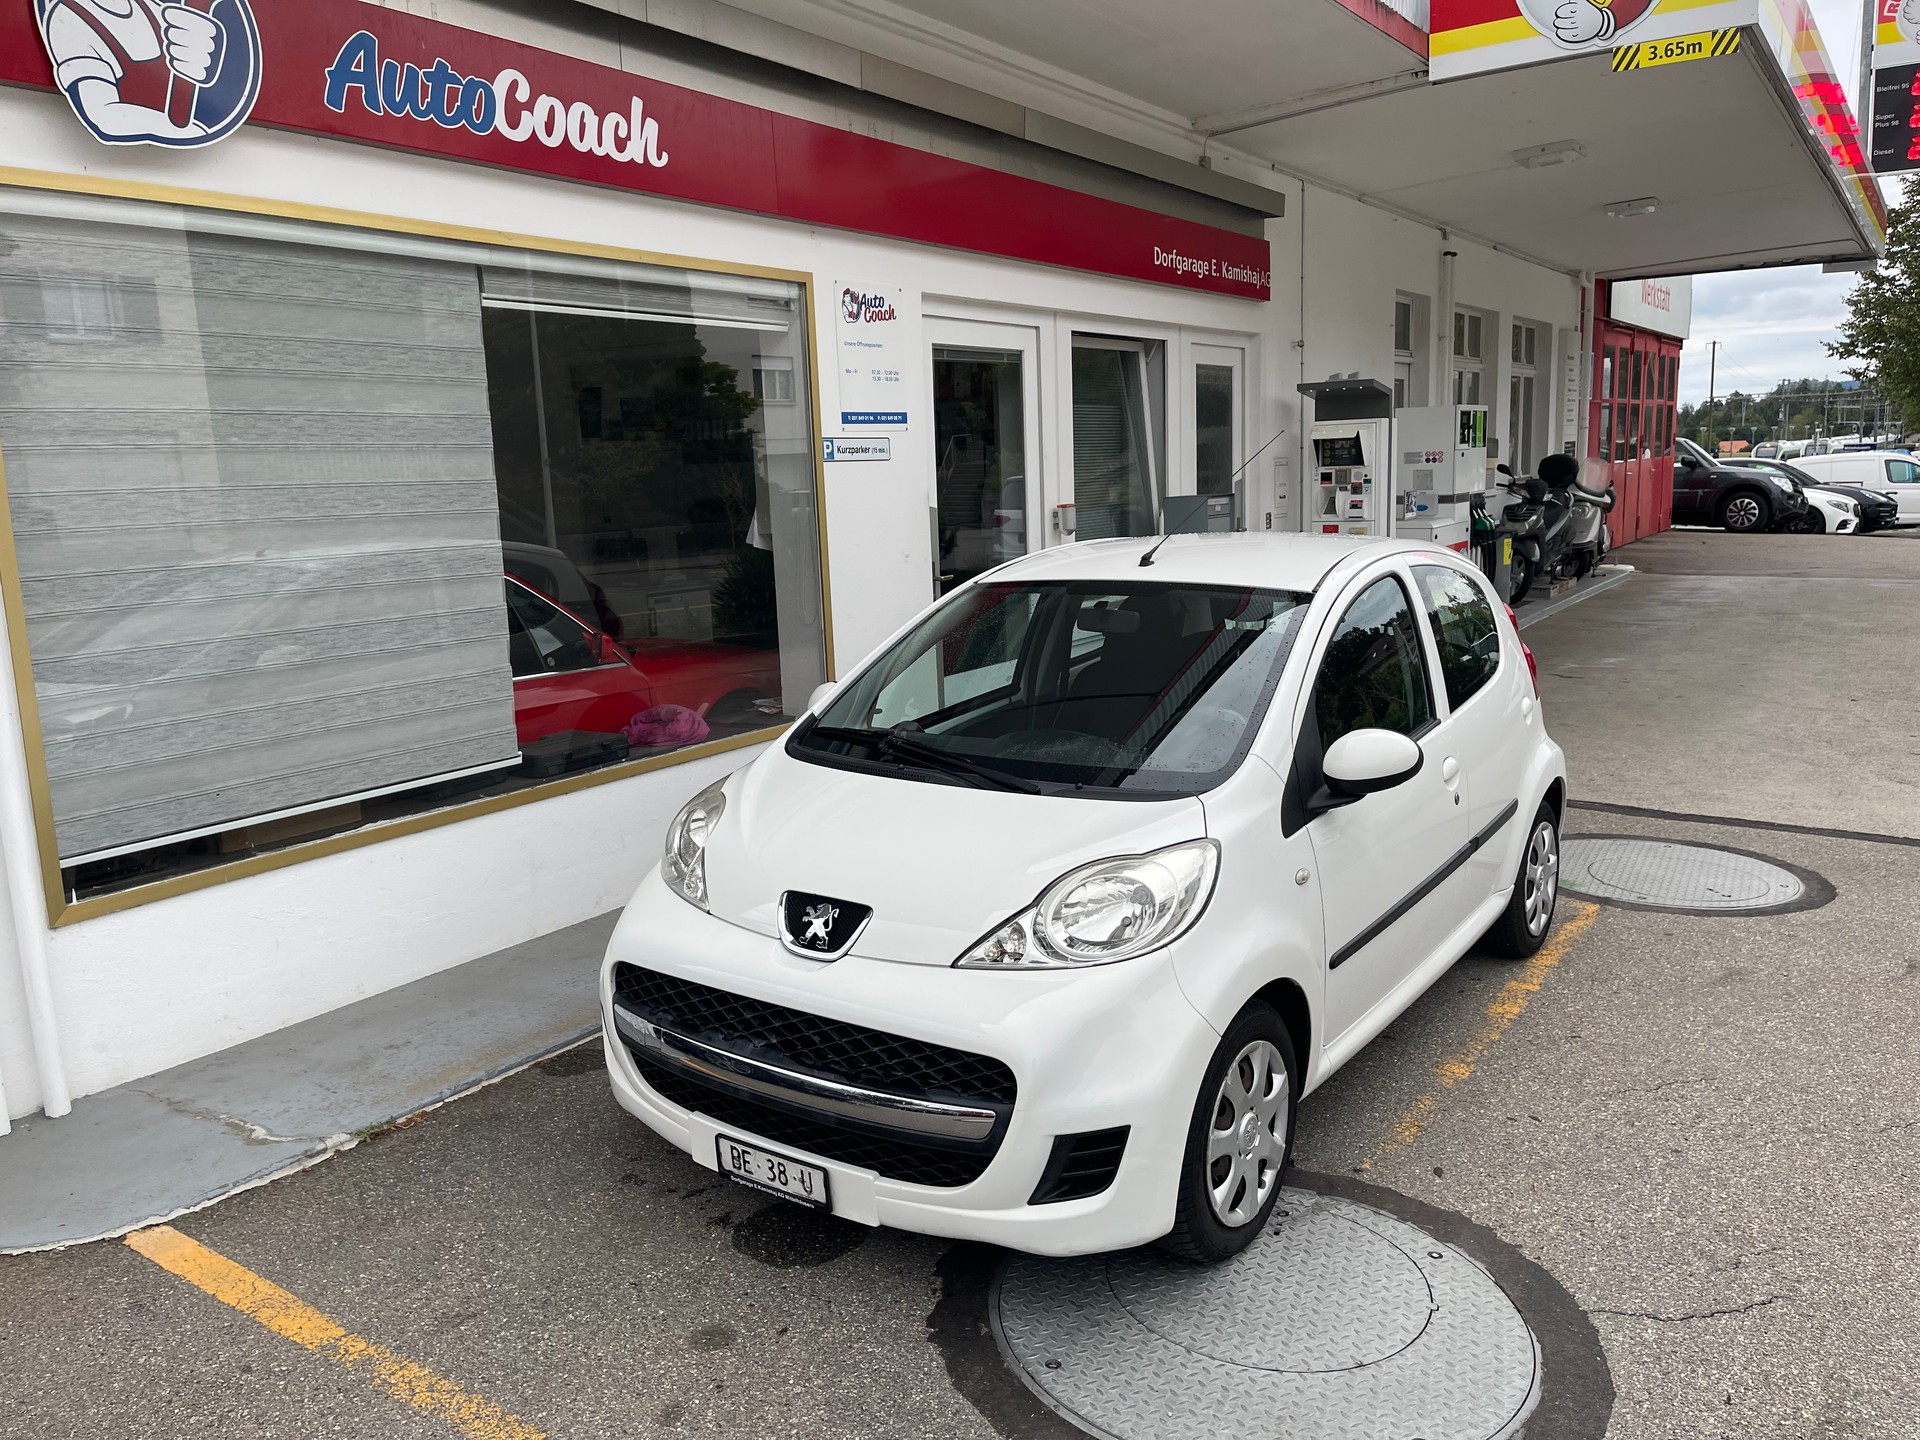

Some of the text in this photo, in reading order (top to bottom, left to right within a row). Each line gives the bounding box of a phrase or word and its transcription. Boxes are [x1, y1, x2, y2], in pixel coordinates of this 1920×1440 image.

[1648, 41, 1703, 61] 3.65m
[1876, 82, 1910, 93] Bleifrei 95
[325, 30, 669, 168] AutoCoach
[1875, 112, 1896, 121] Super
[1891, 119, 1900, 127] 98
[1873, 148, 1895, 156] Diesel
[1154, 246, 1209, 279] Dorfgarage
[1211, 259, 1220, 277] E.
[1222, 261, 1260, 289] Kamishaj
[860, 293, 885, 311] Auto
[1641, 278, 1671, 312] Werkstatt
[864, 304, 897, 323] Coach
[837, 445, 870, 456] Kurzparker
